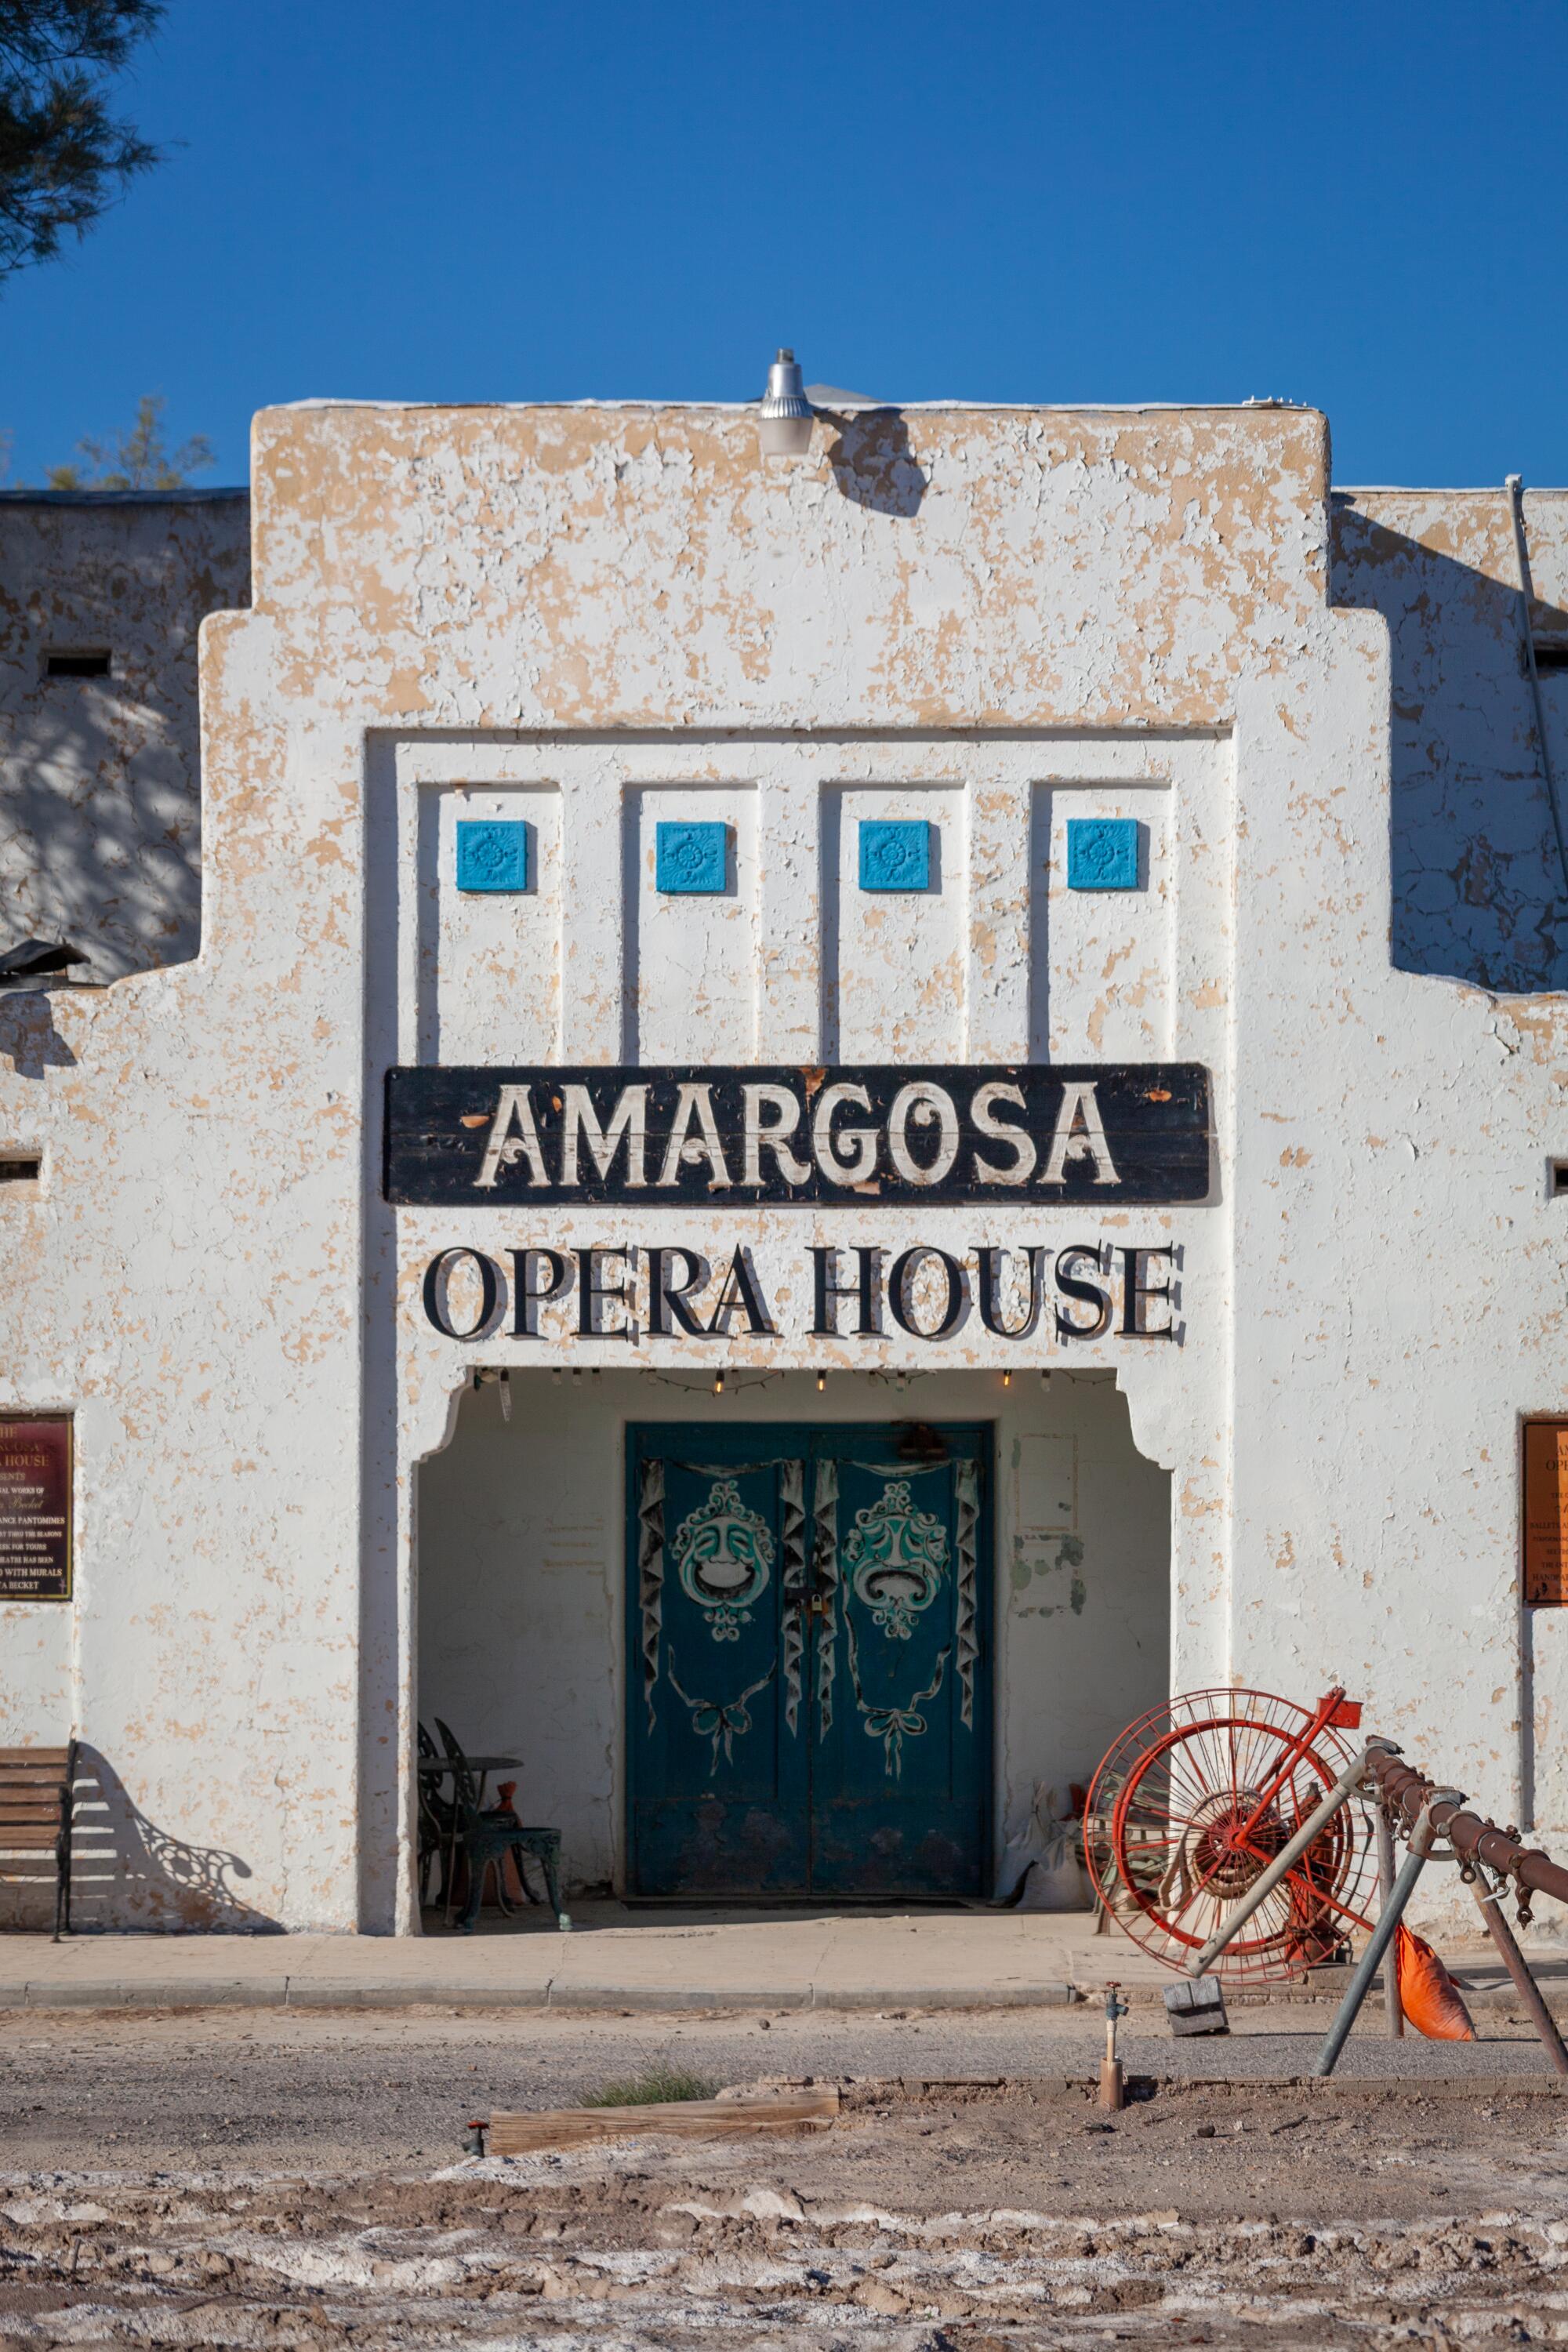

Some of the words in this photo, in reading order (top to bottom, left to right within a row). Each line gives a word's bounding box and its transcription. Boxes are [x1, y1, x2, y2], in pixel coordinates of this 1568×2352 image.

[472, 1081, 1122, 1189] AMARGOSA
[421, 1243, 775, 1341] OPERA
[805, 1240, 1178, 1343] HOUSE
[5, 1454, 50, 1467] HOUSE
[18, 1516, 66, 1525] PANTOMIMES
[5, 1568, 28, 1577] WITH
[29, 1568, 63, 1577] MURALS
